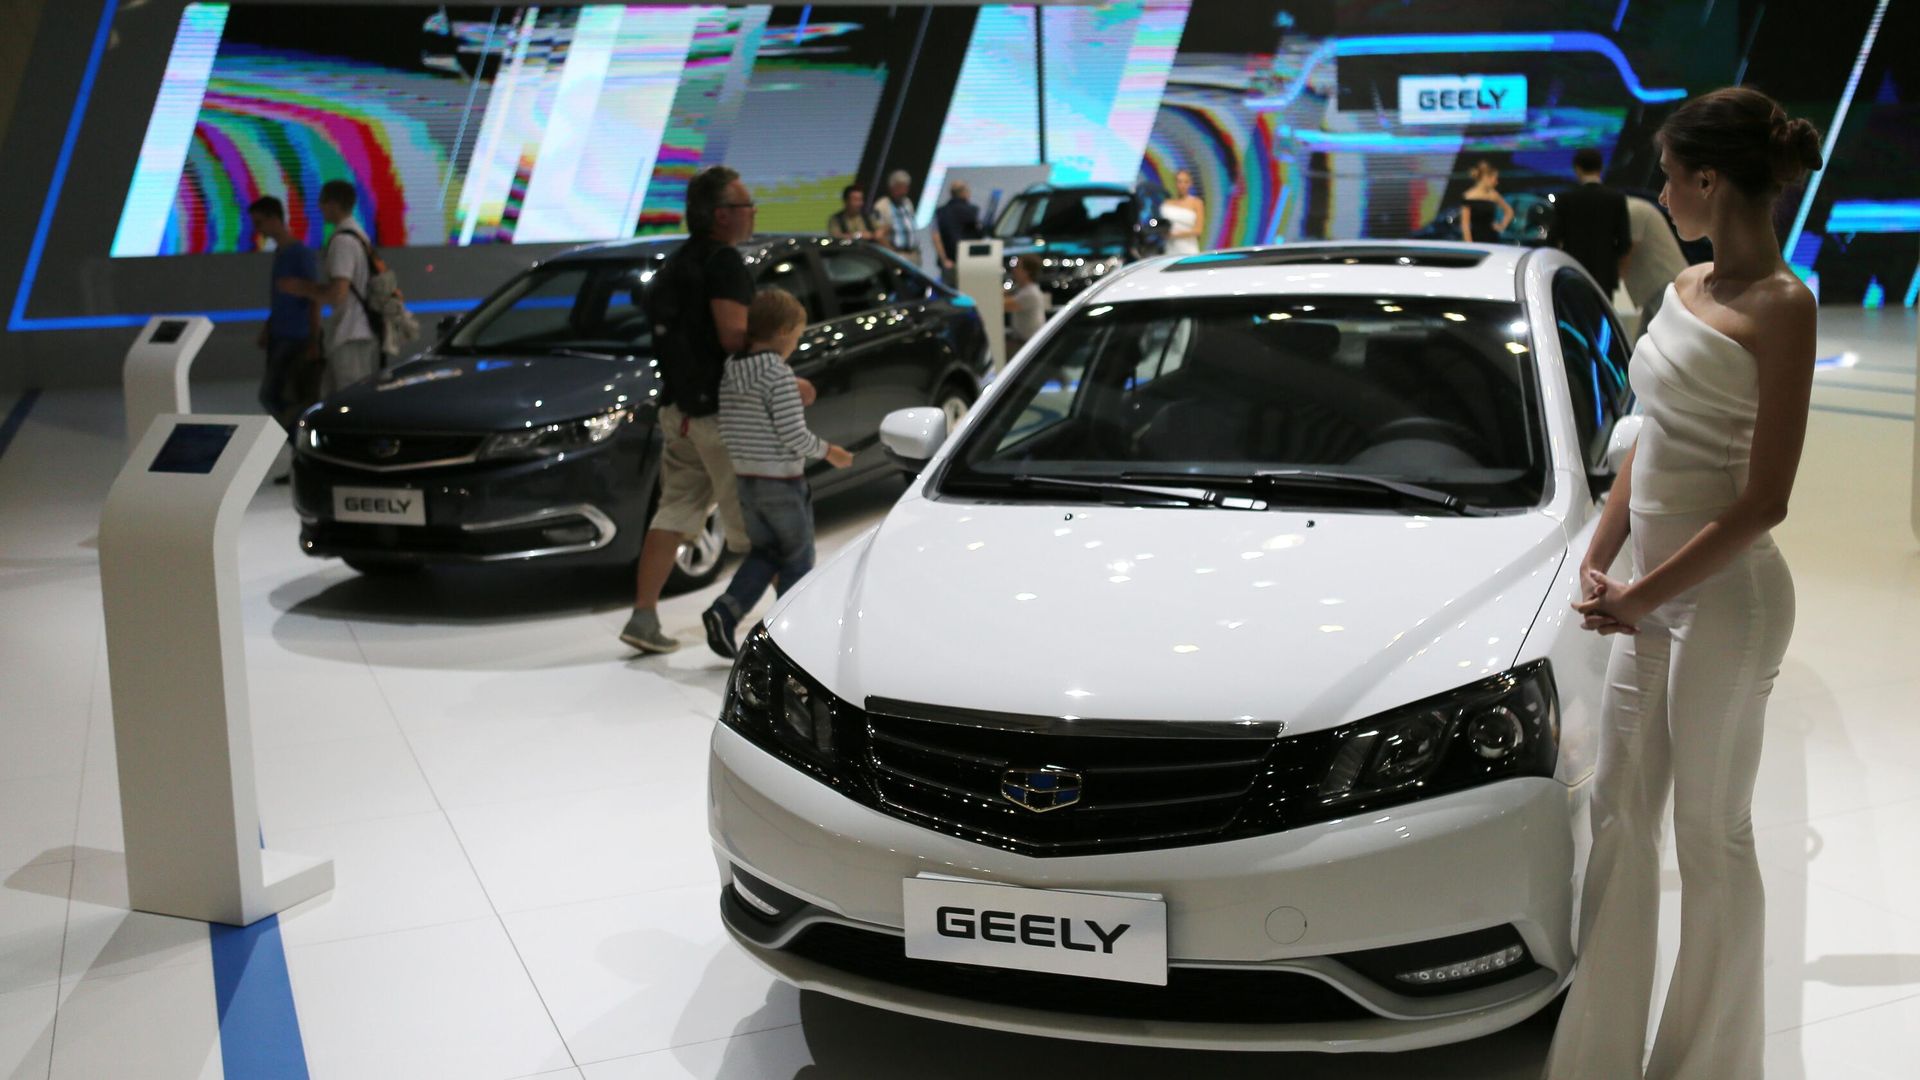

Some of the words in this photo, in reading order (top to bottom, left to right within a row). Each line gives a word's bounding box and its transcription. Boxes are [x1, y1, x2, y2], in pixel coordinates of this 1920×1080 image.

[1418, 88, 1508, 110] GEELY
[344, 496, 412, 514] GEELY
[936, 906, 1131, 954] GEELY
